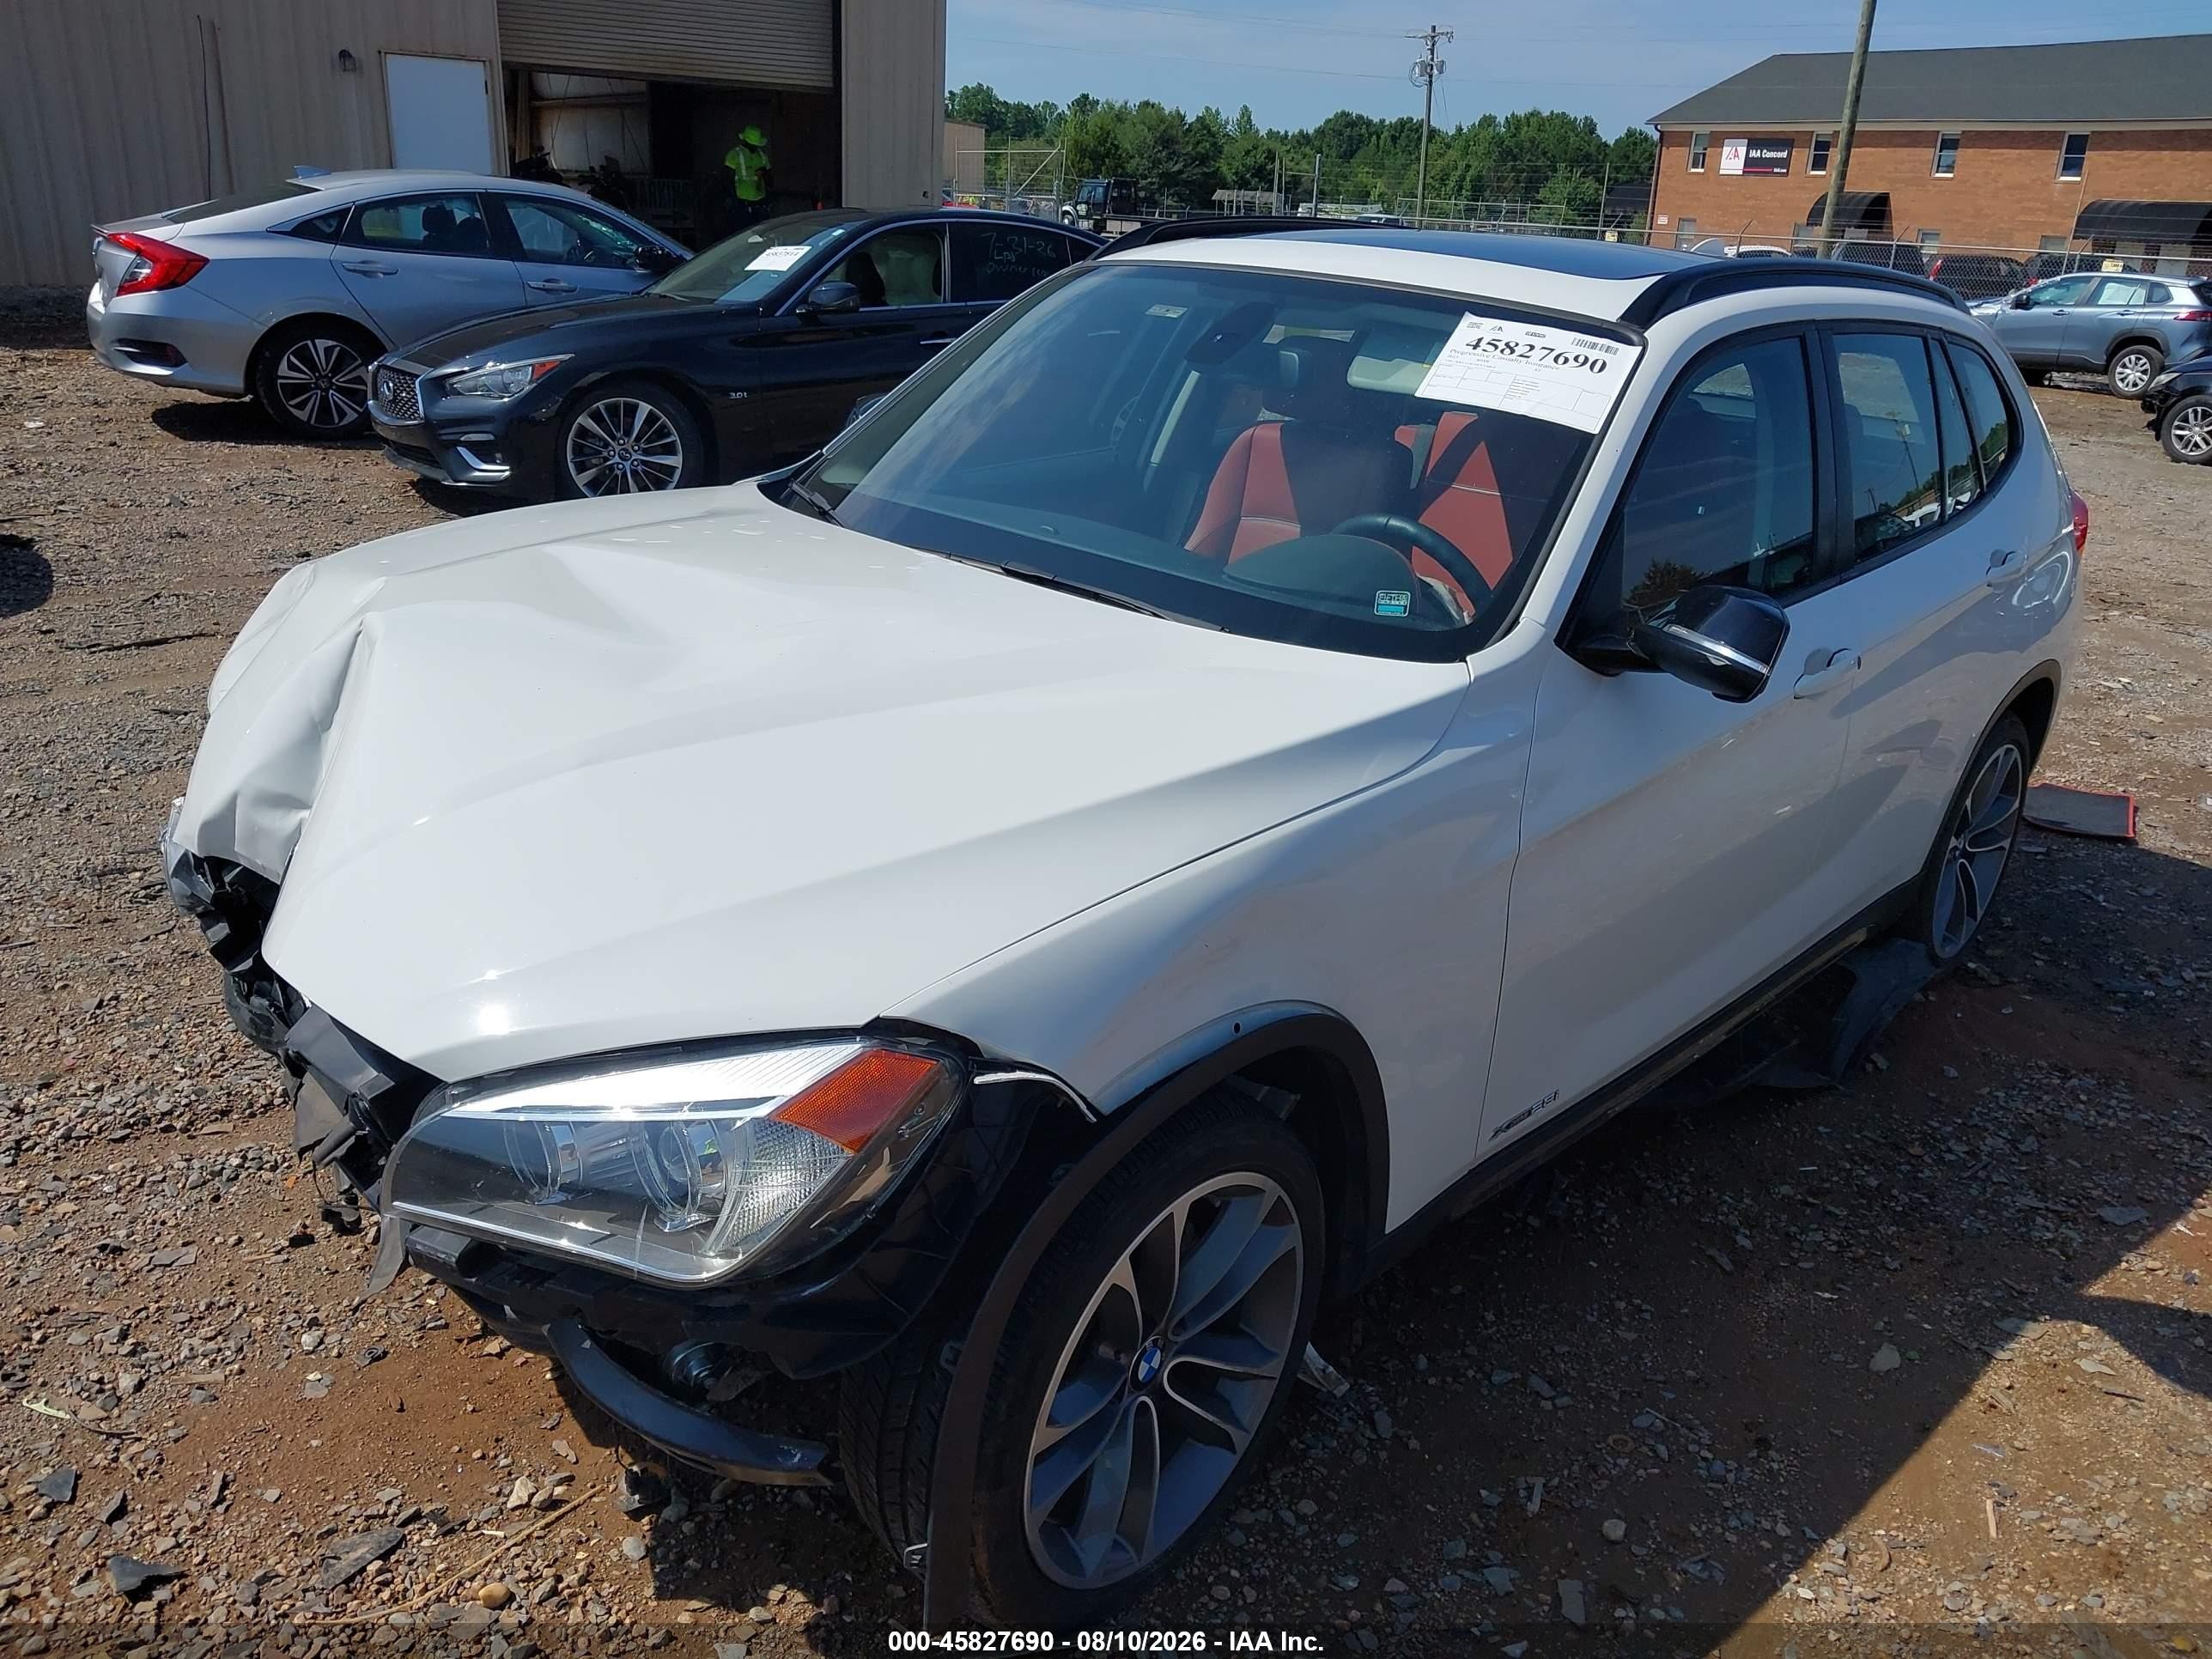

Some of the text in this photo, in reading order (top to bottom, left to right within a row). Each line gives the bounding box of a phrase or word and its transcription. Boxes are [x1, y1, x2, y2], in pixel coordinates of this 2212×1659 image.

[1749, 149, 1788, 158] IAA Concord
[981, 232, 1056, 258] 7-31-26
[1449, 349, 1491, 359] Progressive
[1492, 354, 1522, 364] Casualty
[1525, 359, 1560, 371] Insurance
[1465, 336, 1607, 374] 45827690
